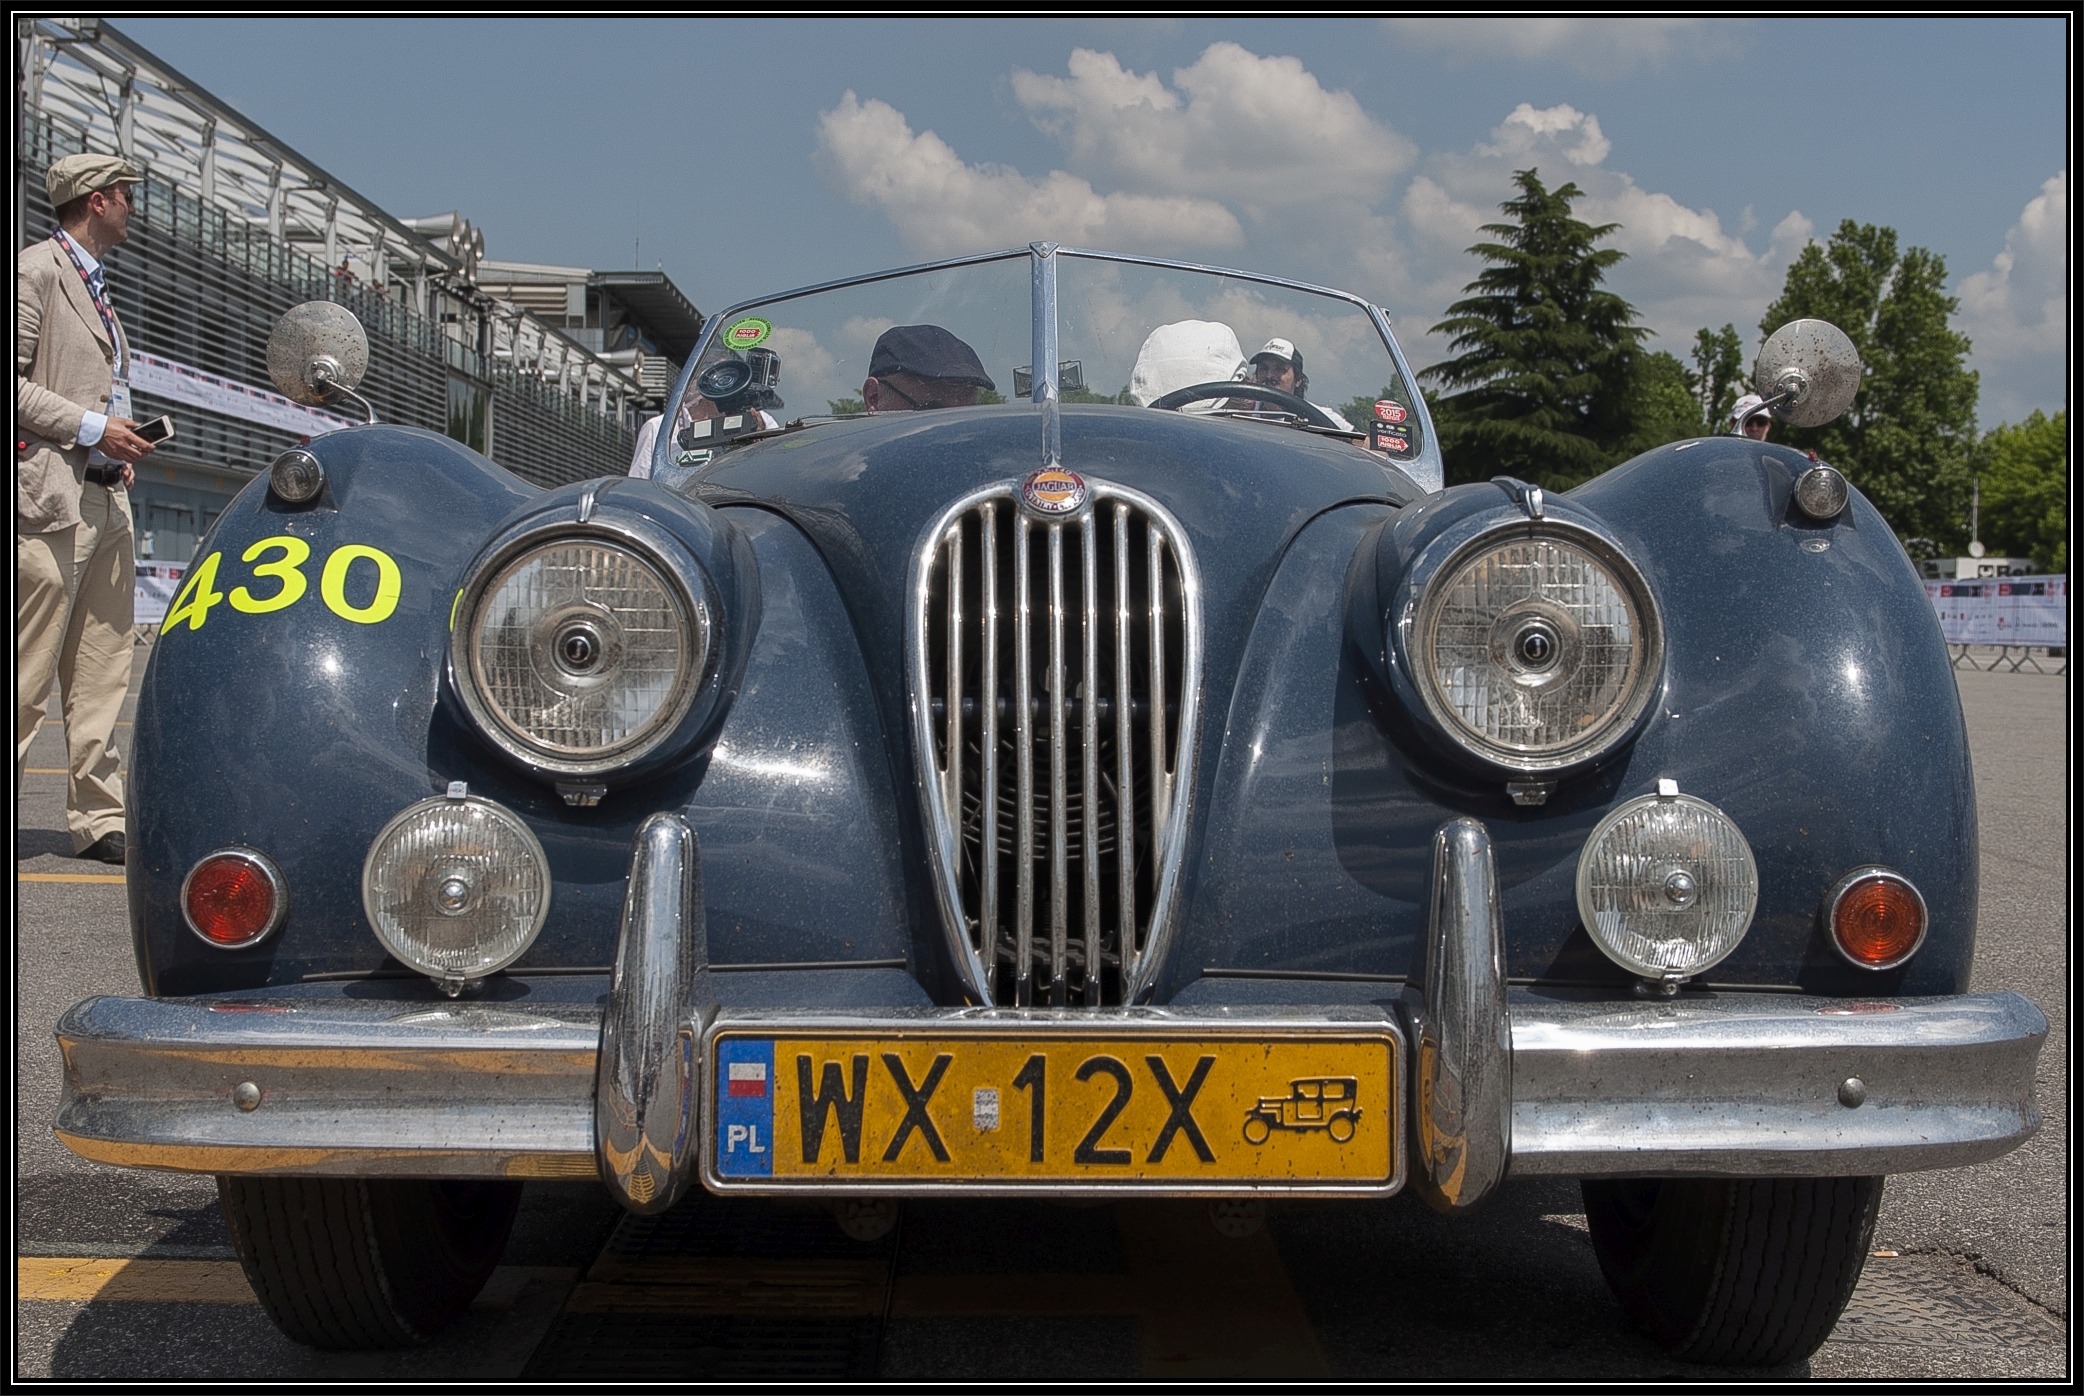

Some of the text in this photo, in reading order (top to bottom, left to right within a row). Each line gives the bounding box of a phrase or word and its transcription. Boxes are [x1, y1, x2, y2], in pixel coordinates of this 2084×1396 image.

[1380, 409, 1401, 417] 2015
[1380, 437, 1400, 445] 1000
[1035, 482, 1074, 491] JAGUAR
[160, 535, 402, 636] 430
[796, 1053, 1217, 1165] WX 12X
[727, 1125, 766, 1153] PL
